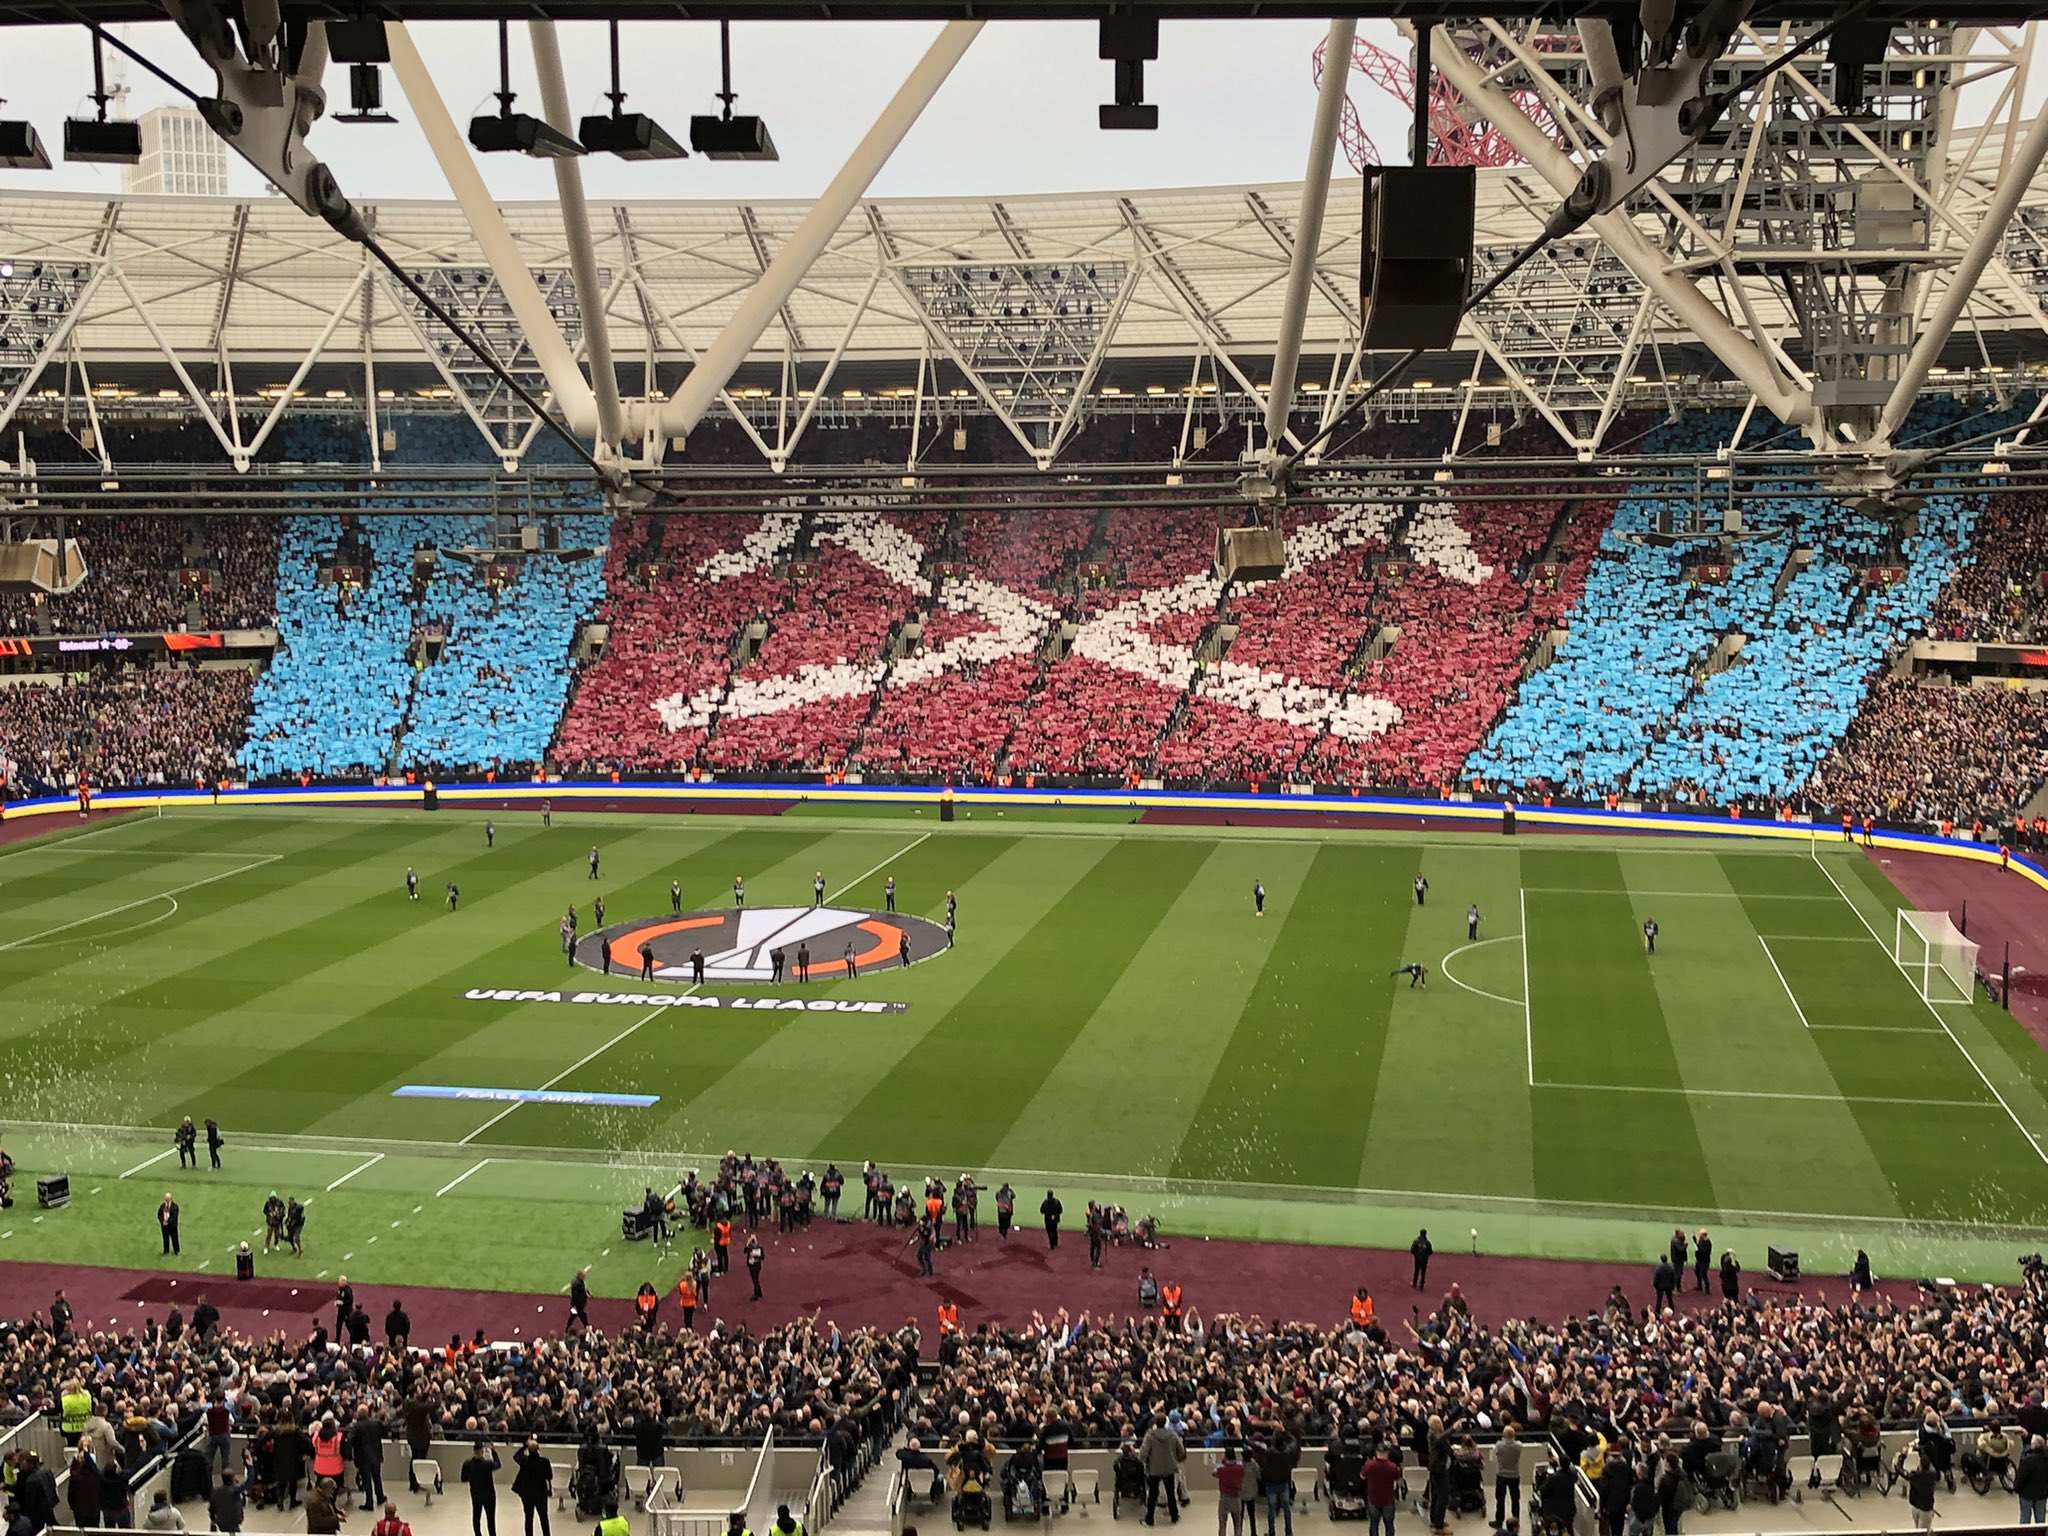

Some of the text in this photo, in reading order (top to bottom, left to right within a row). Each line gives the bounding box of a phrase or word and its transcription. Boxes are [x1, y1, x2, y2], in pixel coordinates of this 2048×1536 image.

[465, 989, 561, 1001] UEFA
[572, 992, 721, 1007] EUROPA
[731, 998, 888, 1012] LEAGUE
